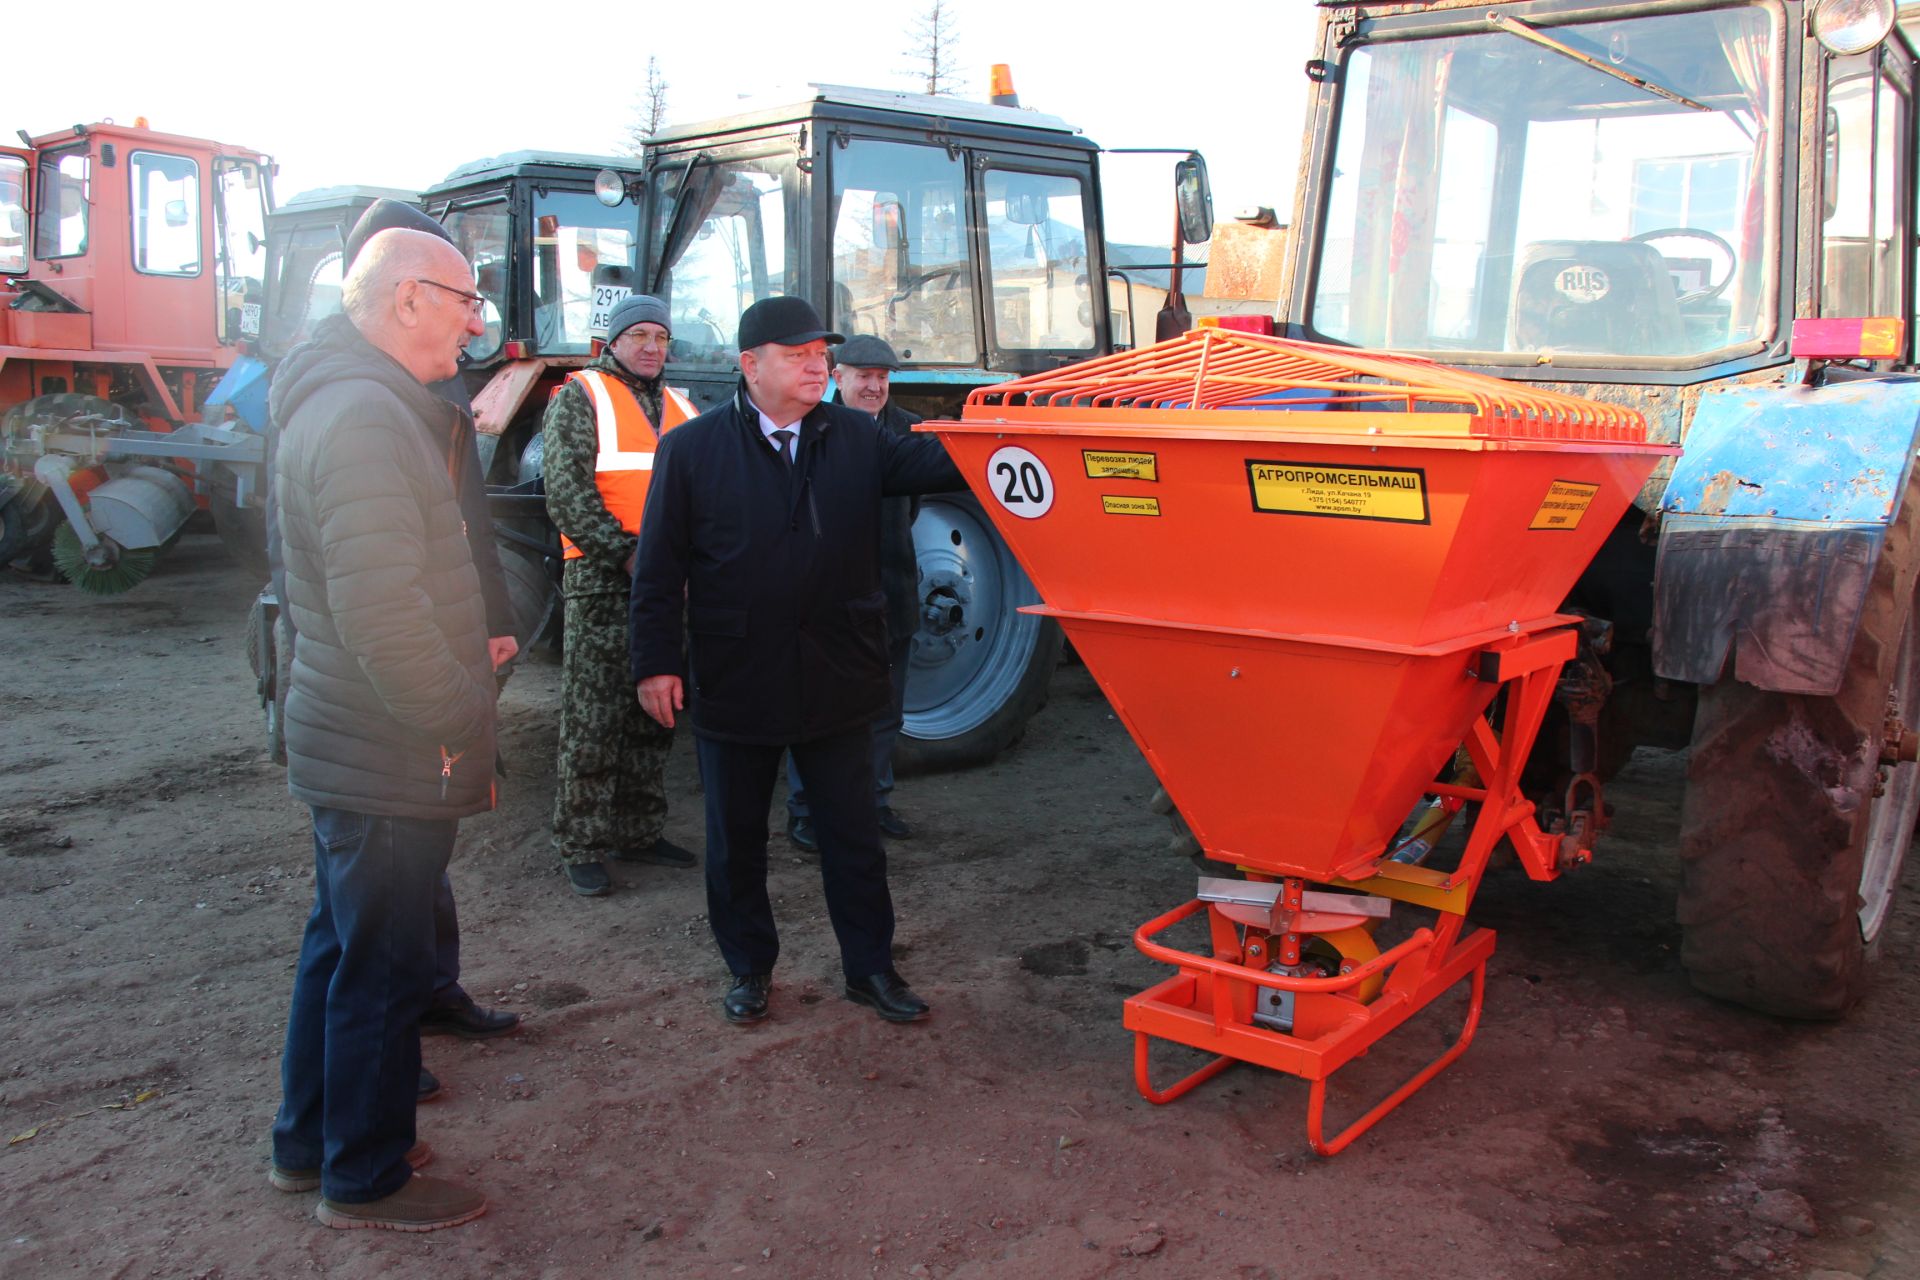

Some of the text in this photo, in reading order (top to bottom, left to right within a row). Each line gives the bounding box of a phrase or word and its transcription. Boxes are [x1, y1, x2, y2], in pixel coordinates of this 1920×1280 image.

[1563, 271, 1605, 291] RUS
[1086, 454, 1153, 465] Перевозка людей
[996, 462, 1044, 504] 20
[1258, 468, 1416, 490] АГРОПРОМСЕЛЬМАШ
[1104, 501, 1130, 509] Опасная
